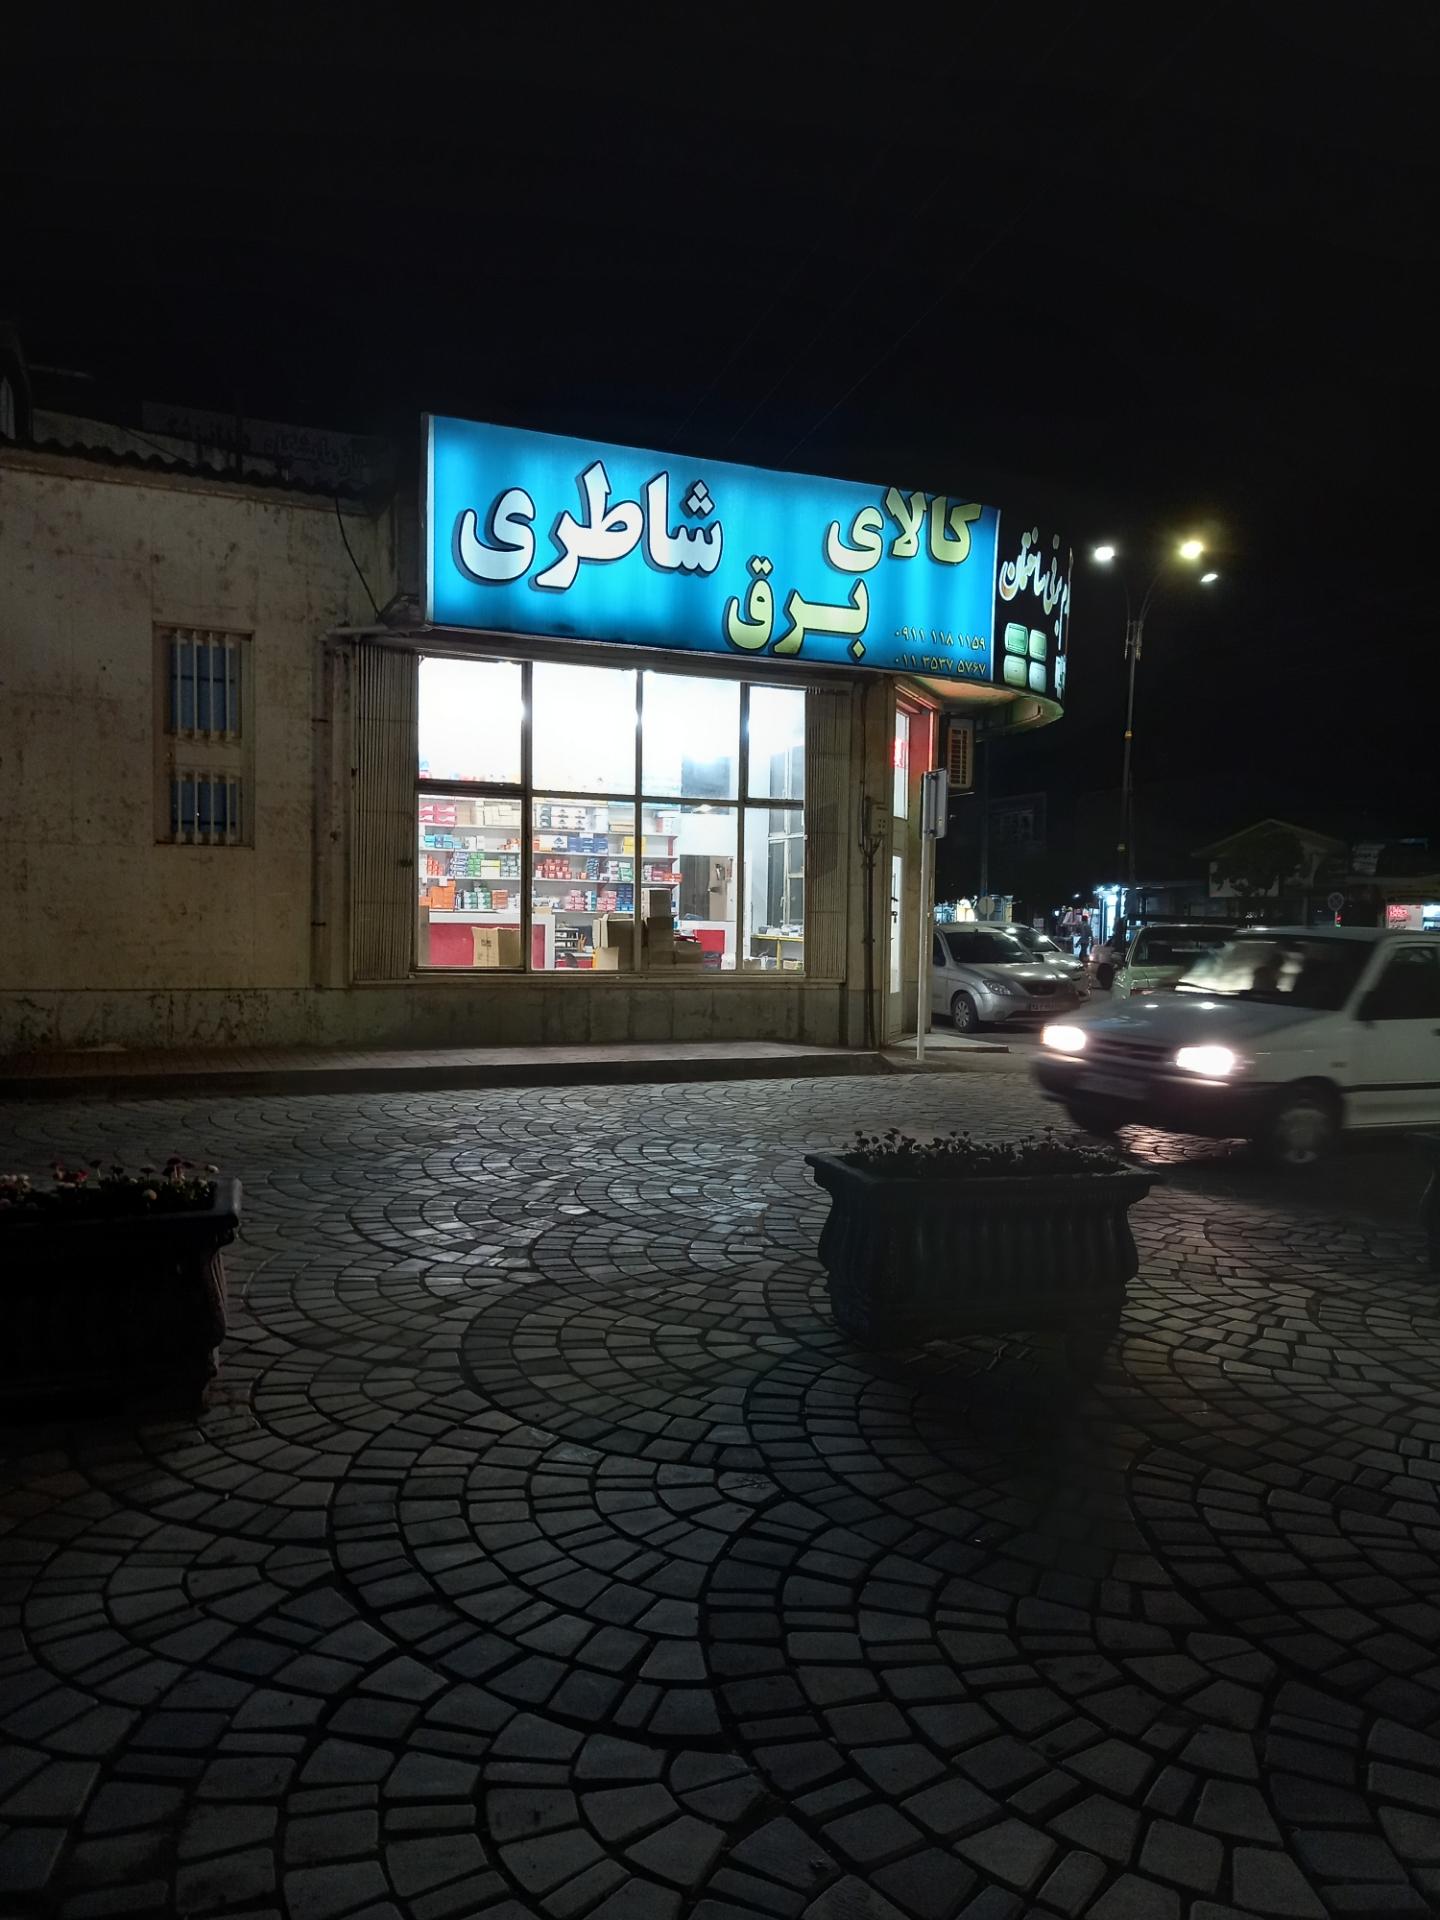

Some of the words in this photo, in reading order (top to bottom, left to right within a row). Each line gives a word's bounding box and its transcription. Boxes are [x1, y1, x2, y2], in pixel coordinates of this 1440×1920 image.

[455, 460, 723, 591] شاطری
[826, 486, 982, 573] کالای
[728, 556, 870, 662] برق
[895, 625, 926, 641] ۰۹۱۱
[931, 629, 954, 646] ۱۱۸
[957, 633, 987, 651] ۱۱۵۹
[895, 654, 917, 666] ۰۱۱
